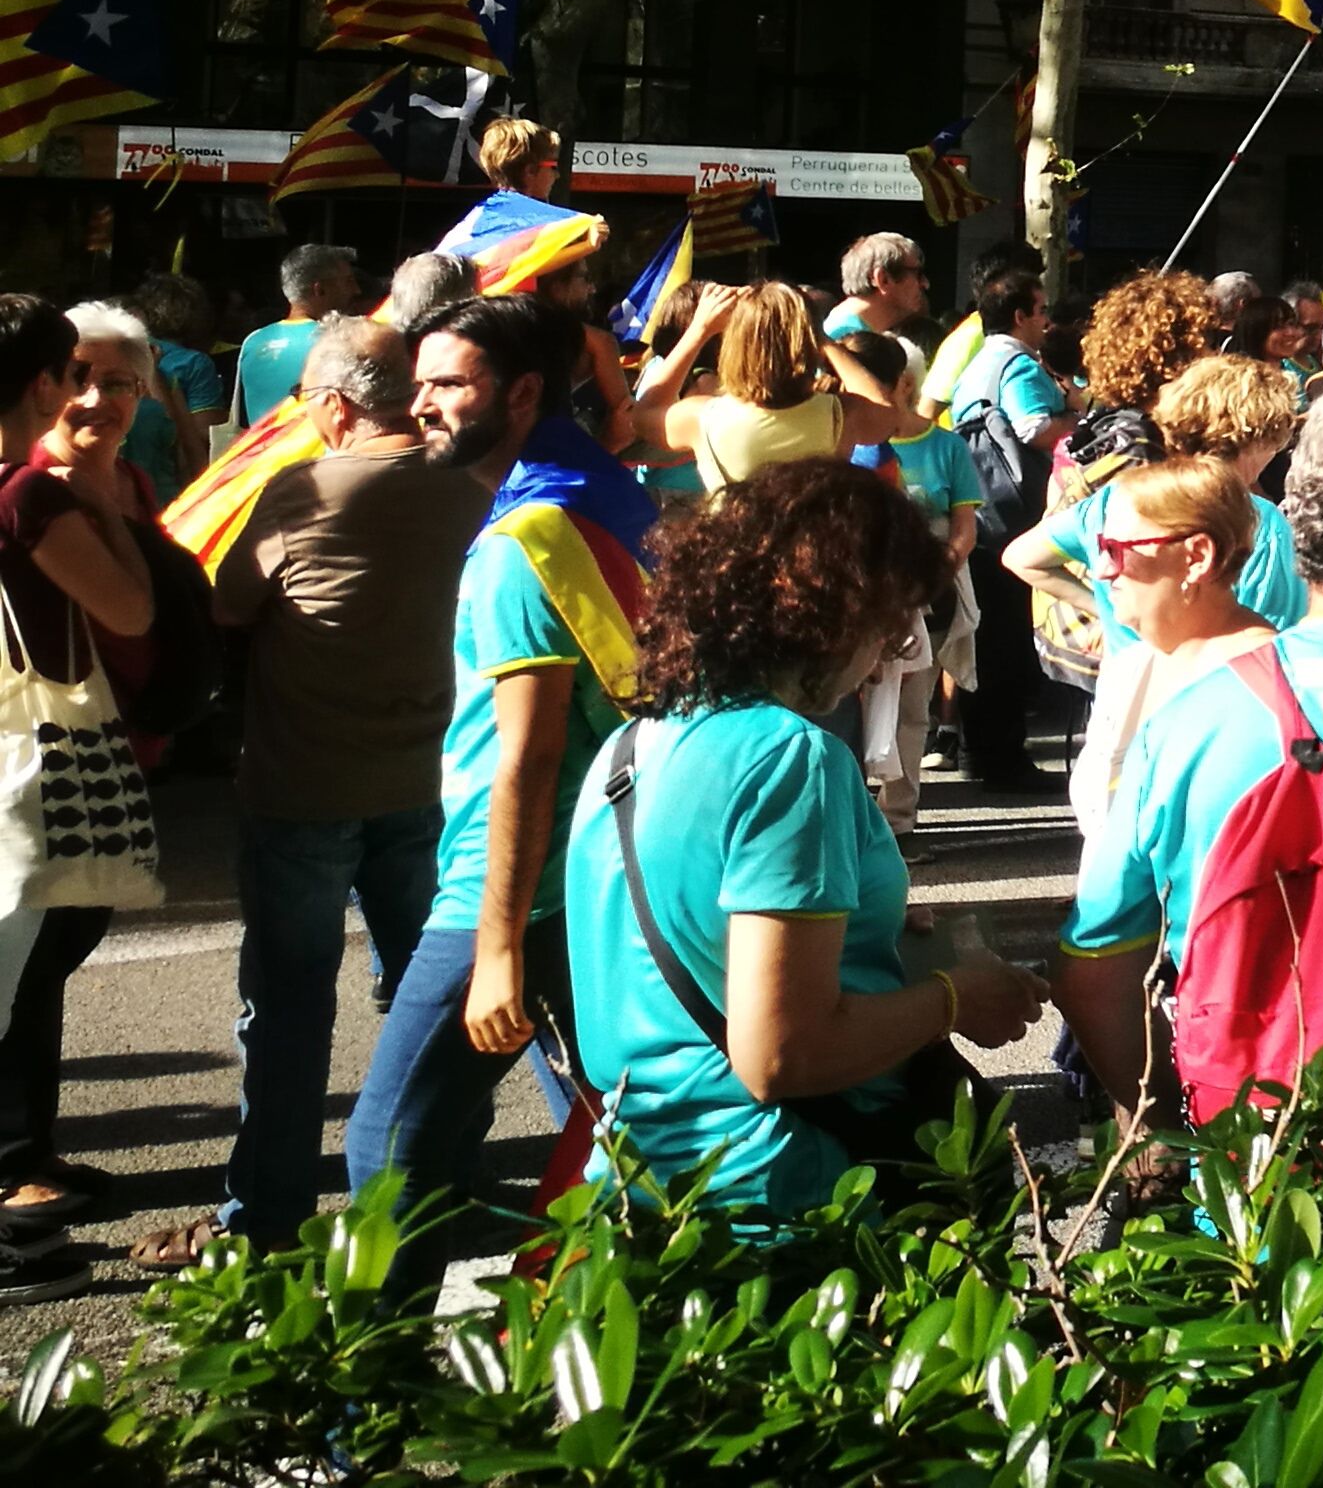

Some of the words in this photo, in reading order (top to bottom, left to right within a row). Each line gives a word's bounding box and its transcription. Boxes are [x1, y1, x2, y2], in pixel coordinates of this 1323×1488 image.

[792, 155, 888, 172] Perruqueria
[790, 178, 843, 193] Centre
[850, 179, 872, 194] de
